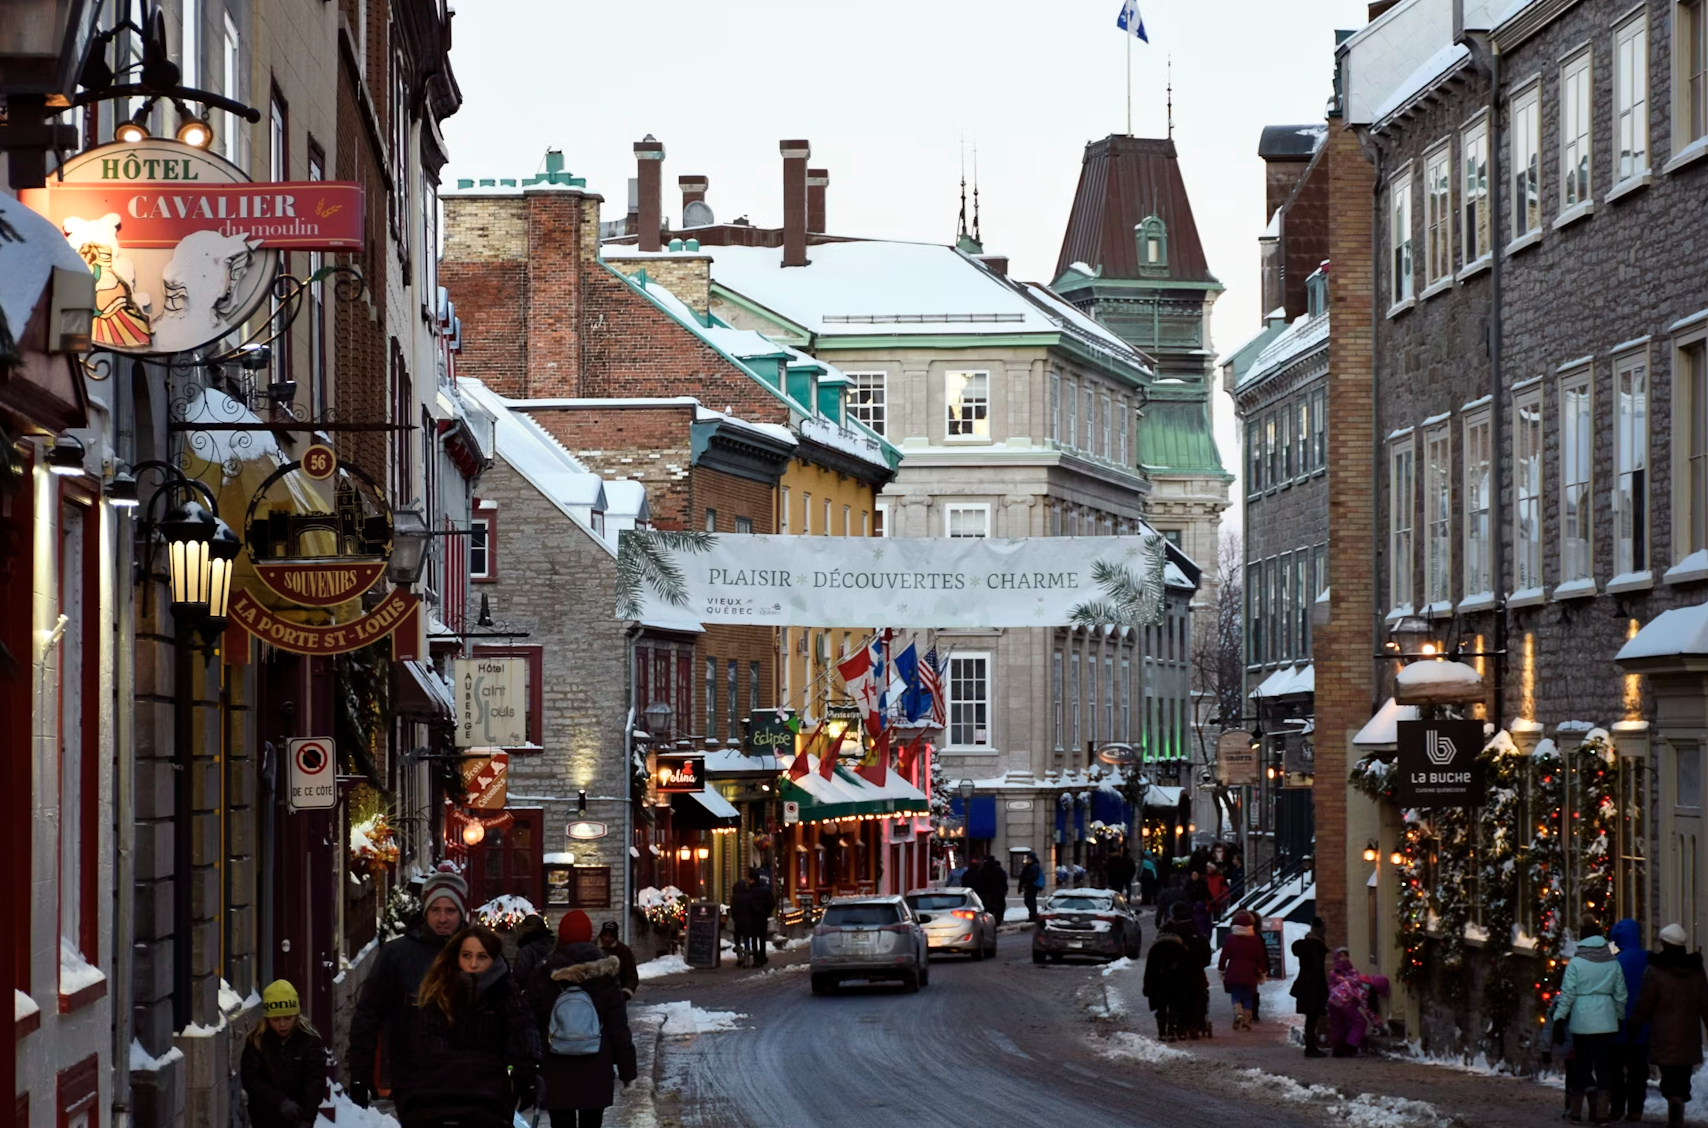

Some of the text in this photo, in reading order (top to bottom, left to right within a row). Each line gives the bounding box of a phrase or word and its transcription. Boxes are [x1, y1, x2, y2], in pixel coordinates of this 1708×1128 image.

[101, 153, 199, 180] HÔTEL
[127, 195, 297, 219] CAVALIER
[218, 218, 319, 237] du moulin
[310, 454, 327, 470] 56
[284, 569, 357, 598] SOUVENIRS
[708, 568, 1079, 589] PLAISIR DÉCOUVERTES CHARME
[706, 597, 742, 606] VIEUX
[706, 606, 753, 616] QUÉBEC
[234, 598, 257, 624] LA
[256, 617, 319, 648] PORTE
[478, 664, 505, 673] Hôtel
[464, 672, 472, 739] AUBERGE
[753, 727, 791, 747] Eclipse
[659, 768, 698, 787] Polina
[292, 784, 333, 797] DE CE CÔTÉ
[478, 777, 506, 808] Colombes
